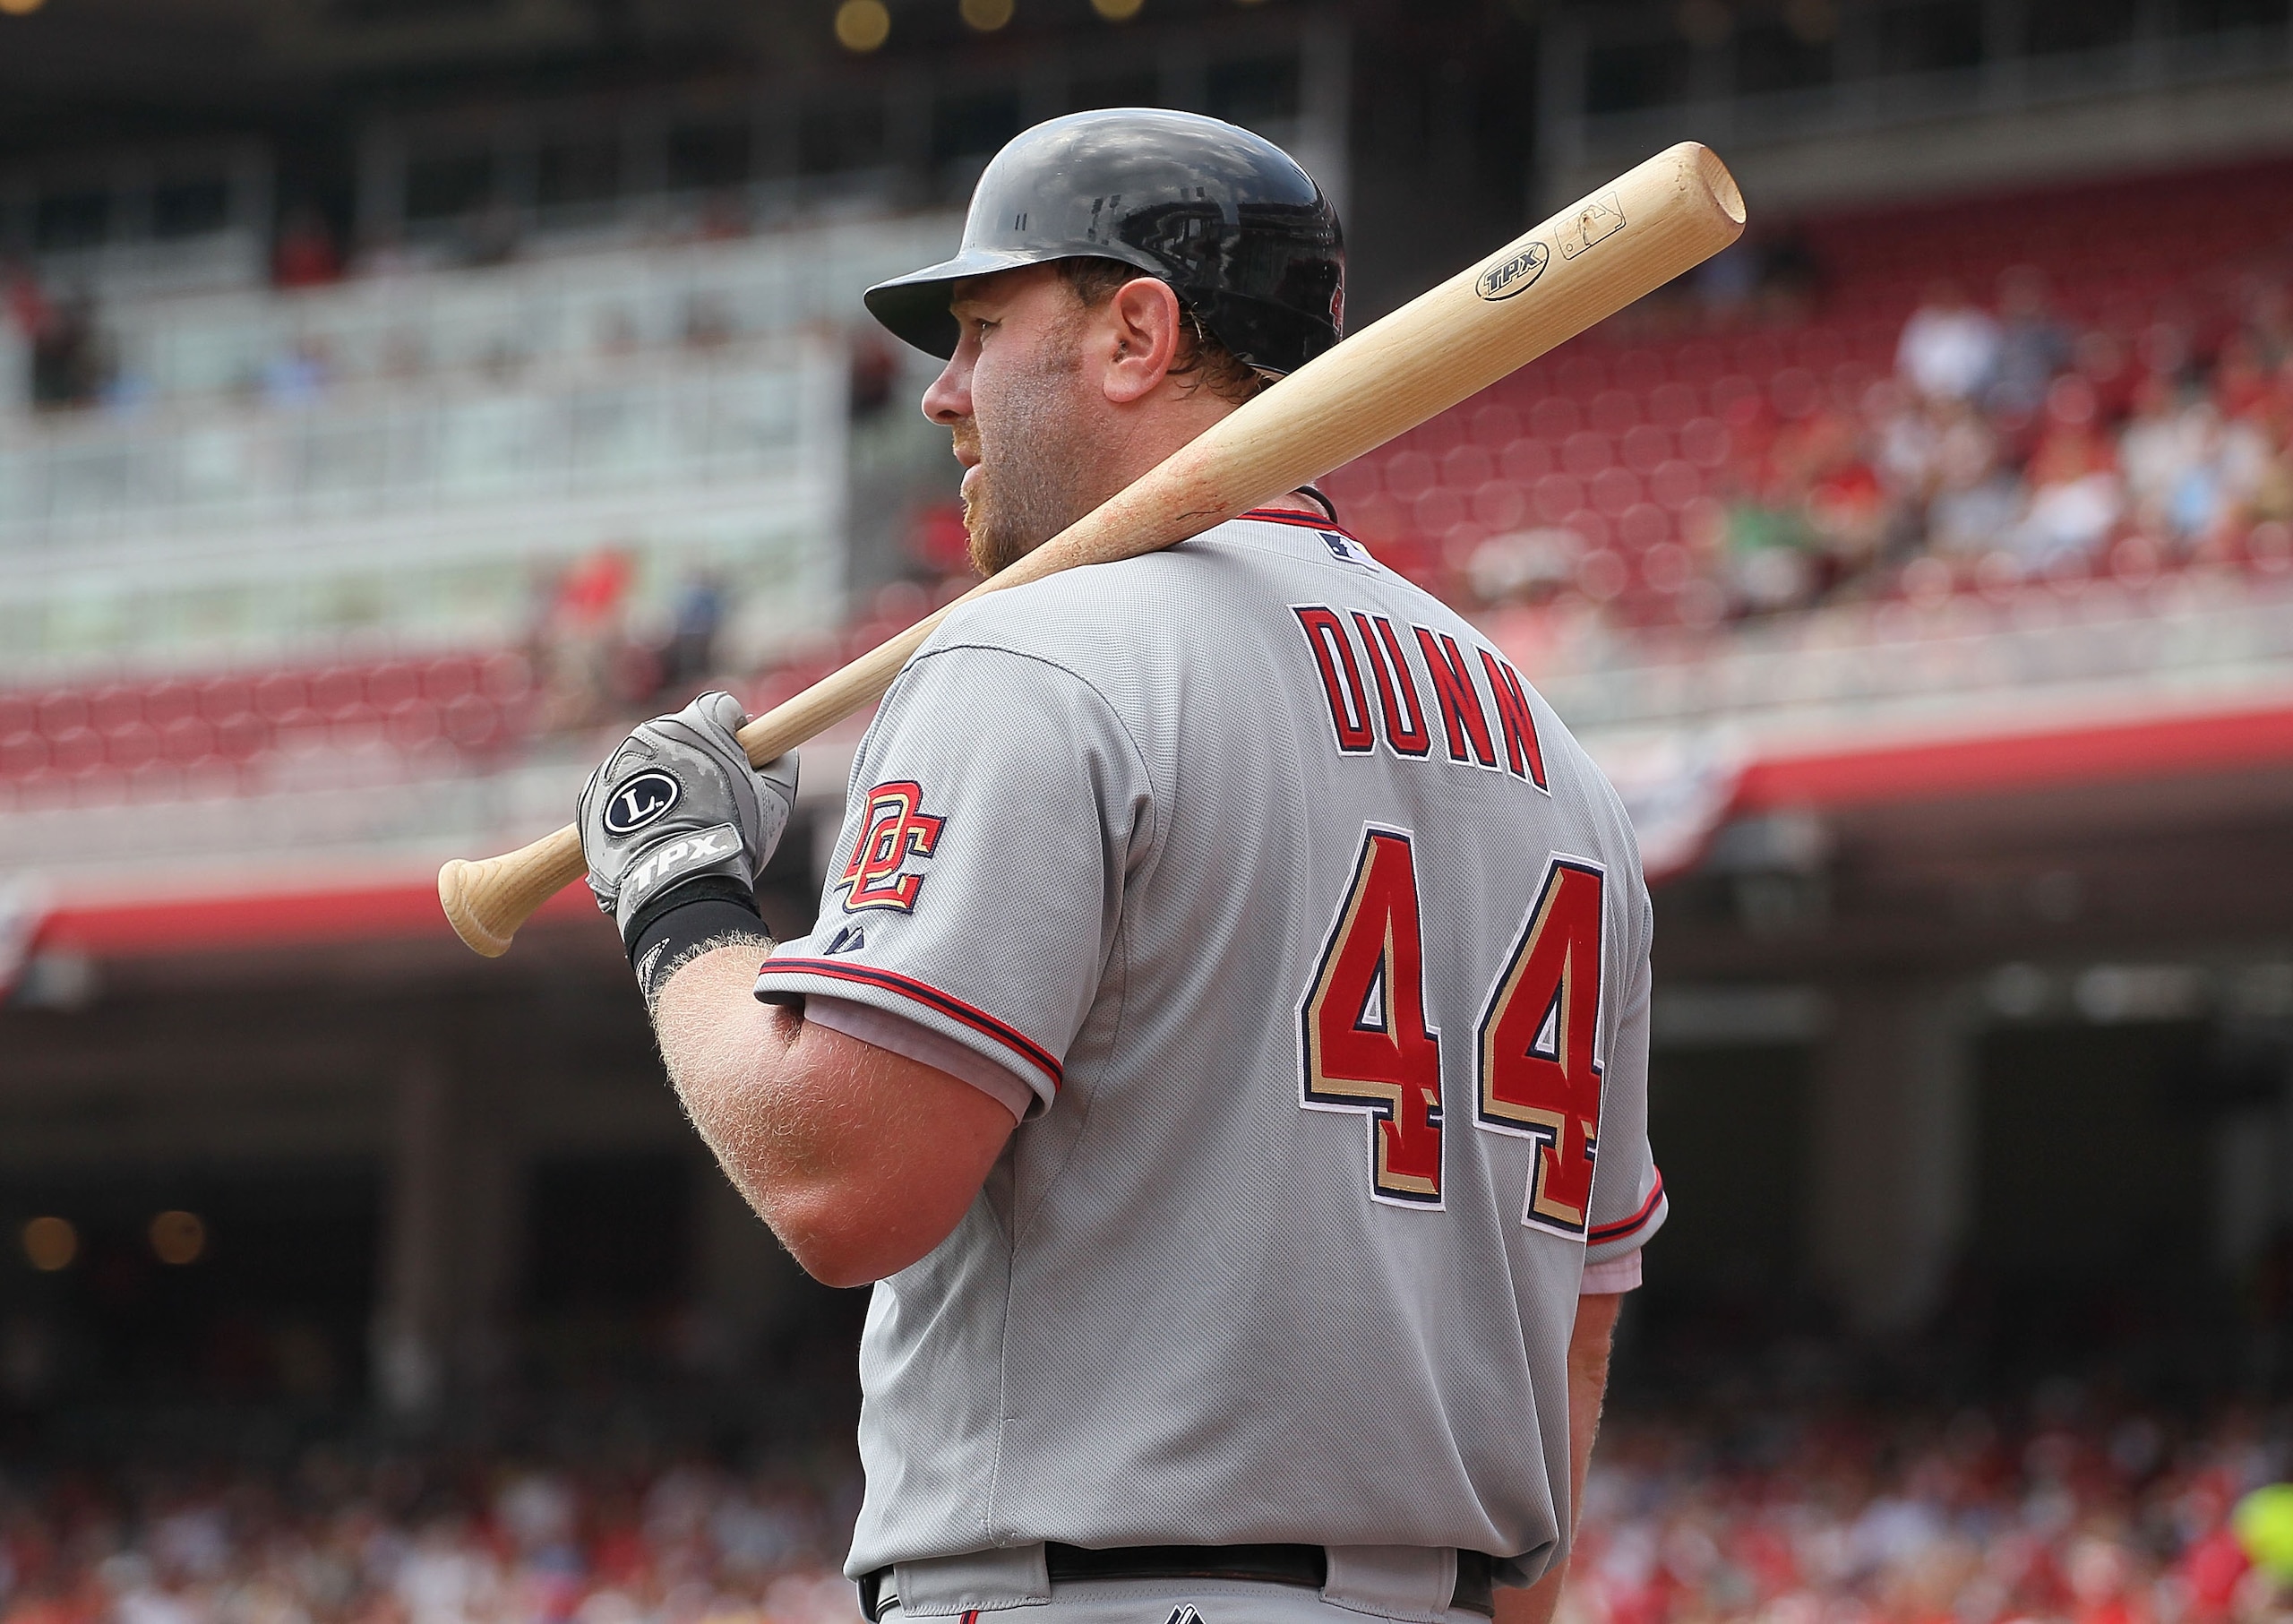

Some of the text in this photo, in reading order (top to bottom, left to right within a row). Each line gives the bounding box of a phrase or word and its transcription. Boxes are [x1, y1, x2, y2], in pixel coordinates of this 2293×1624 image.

[1484, 248, 1542, 296] TPX
[1287, 603, 1550, 796] DUNN
[621, 788, 657, 825] L
[632, 834, 721, 893] TPX
[1295, 821, 1607, 1242] 44
